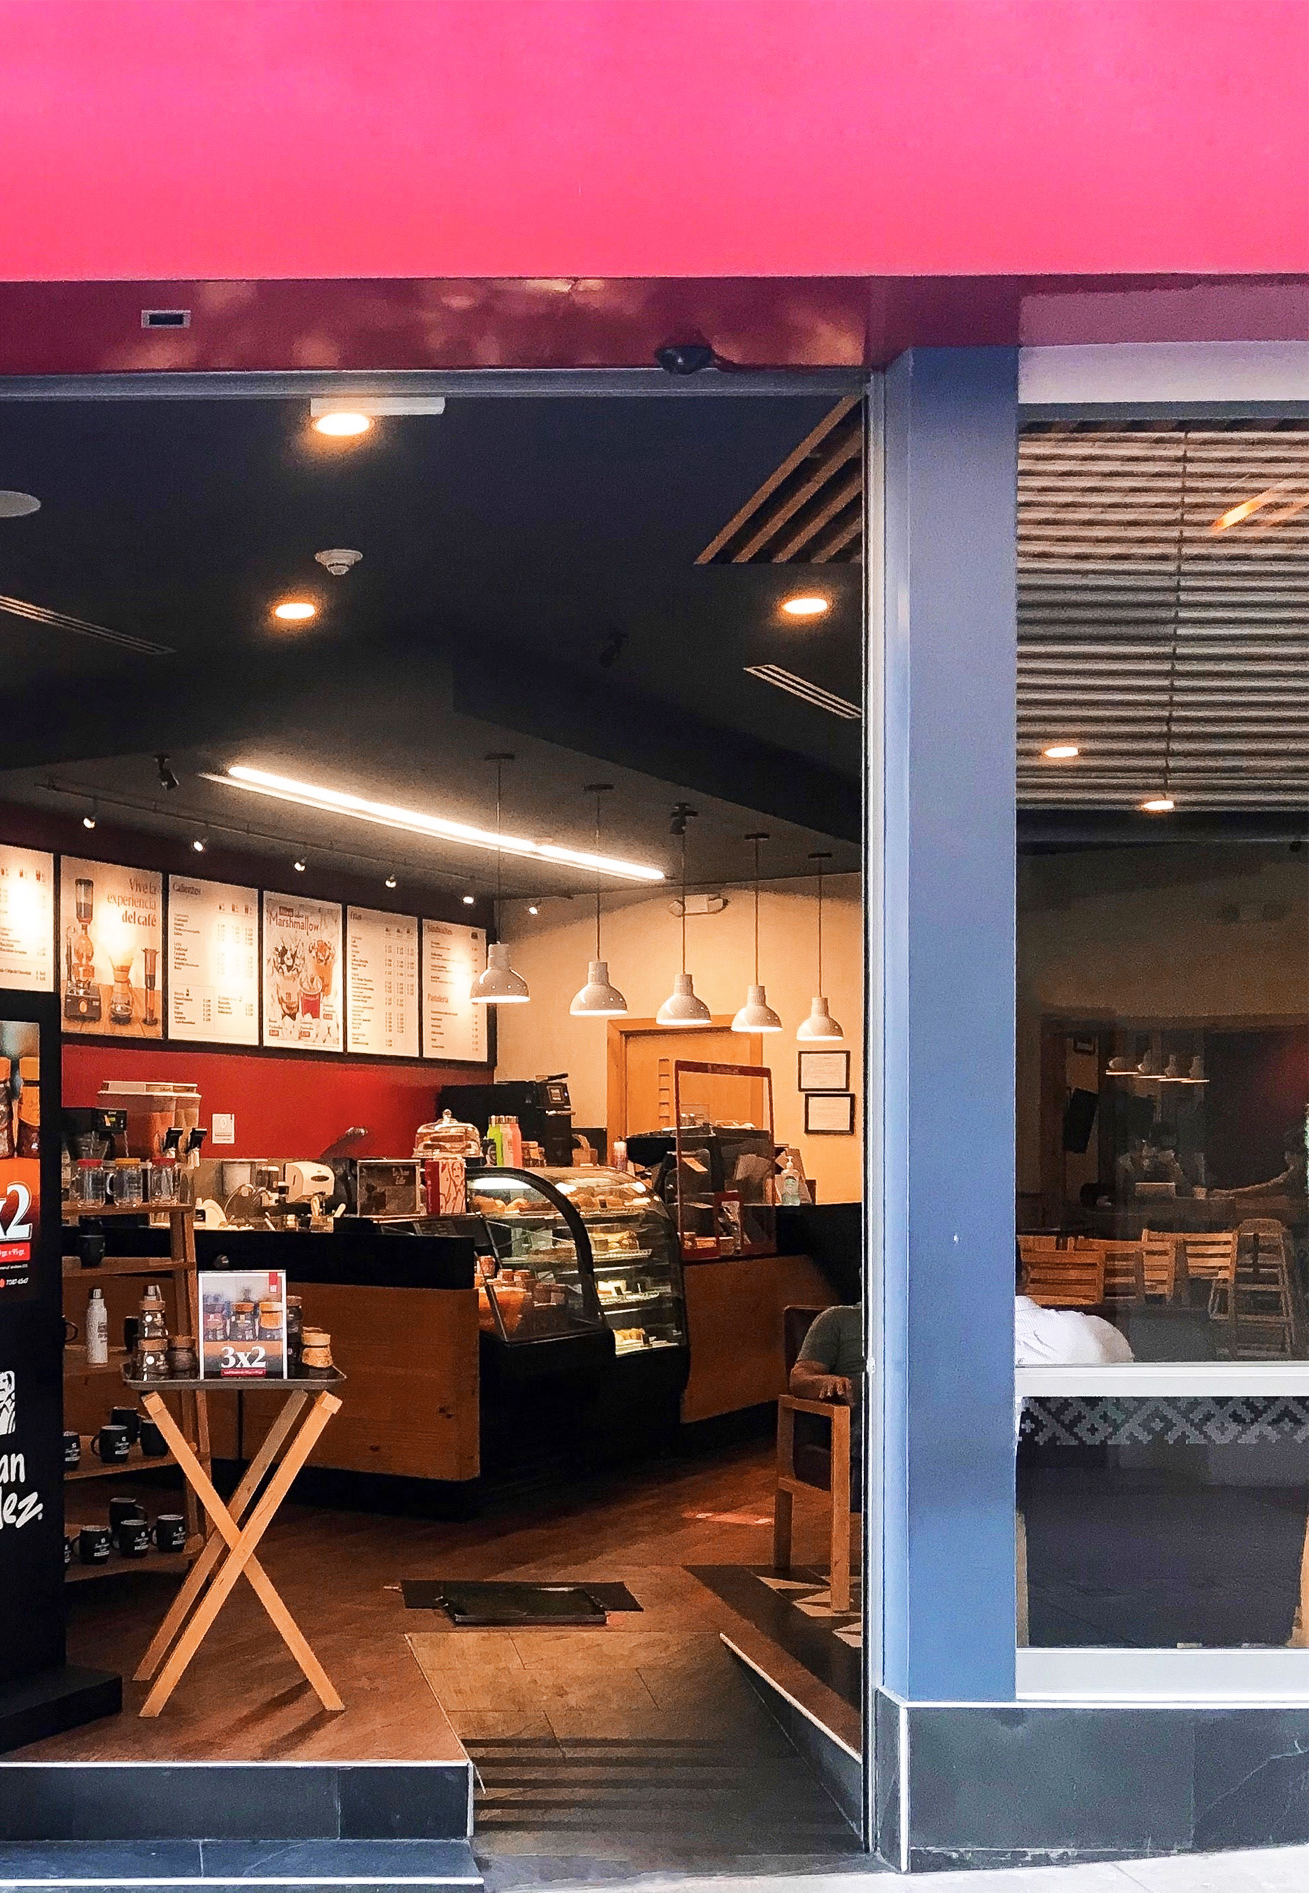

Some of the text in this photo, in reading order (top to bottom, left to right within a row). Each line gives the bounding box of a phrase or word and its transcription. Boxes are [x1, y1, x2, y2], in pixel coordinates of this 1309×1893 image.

[128, 878, 157, 895] Vive la
[107, 893, 157, 911] experiencia
[122, 909, 157, 928] del café
[269, 909, 320, 936] Marshmallow
[221, 1346, 266, 1368] 3x2
